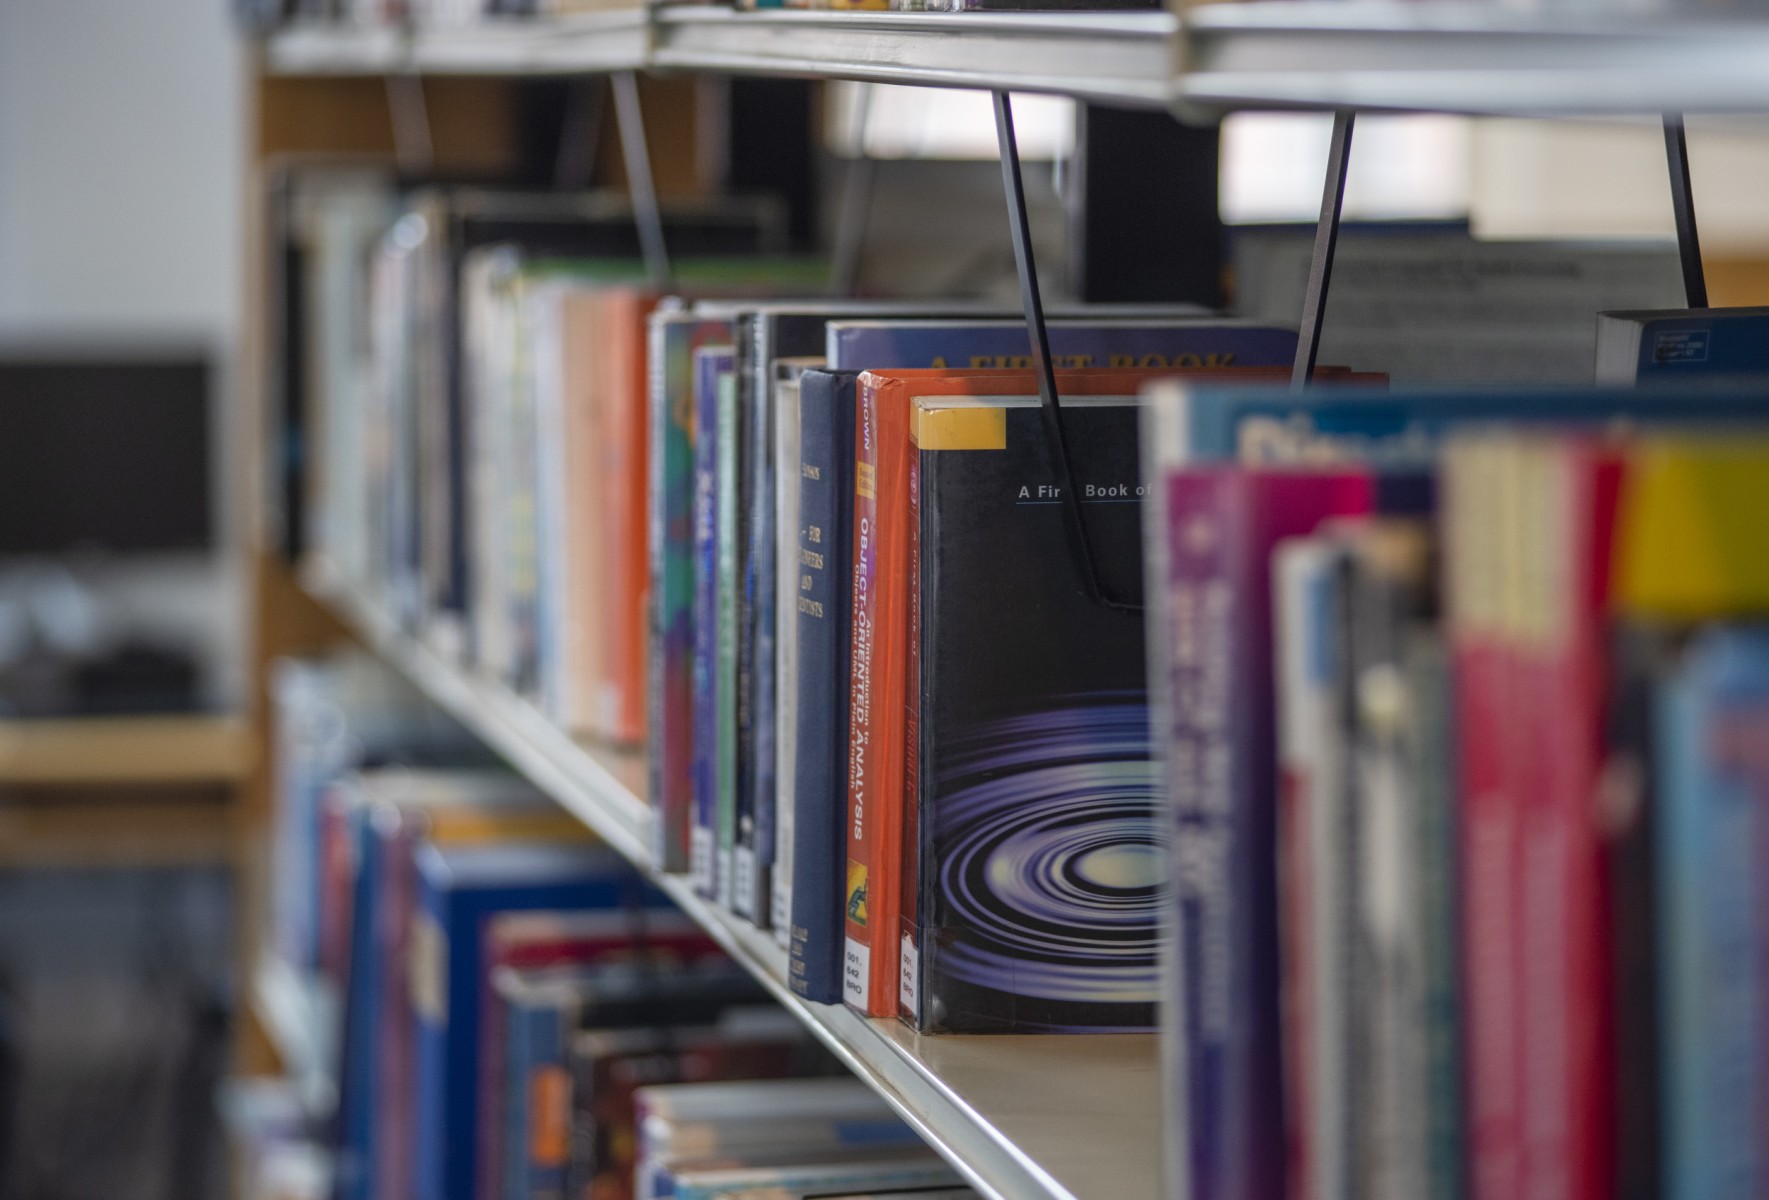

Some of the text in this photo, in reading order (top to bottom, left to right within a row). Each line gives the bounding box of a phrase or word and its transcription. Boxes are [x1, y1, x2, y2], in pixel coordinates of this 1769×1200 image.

[861, 386, 871, 450] BROWN
[1018, 485, 1030, 499] A
[1085, 483, 1128, 497] Book
[1135, 482, 1153, 496] of
[854, 517, 869, 841] OBJECT-ORIENTED ANALYSIS
[863, 619, 871, 745] An Introduction to
[846, 979, 862, 994] BRO
